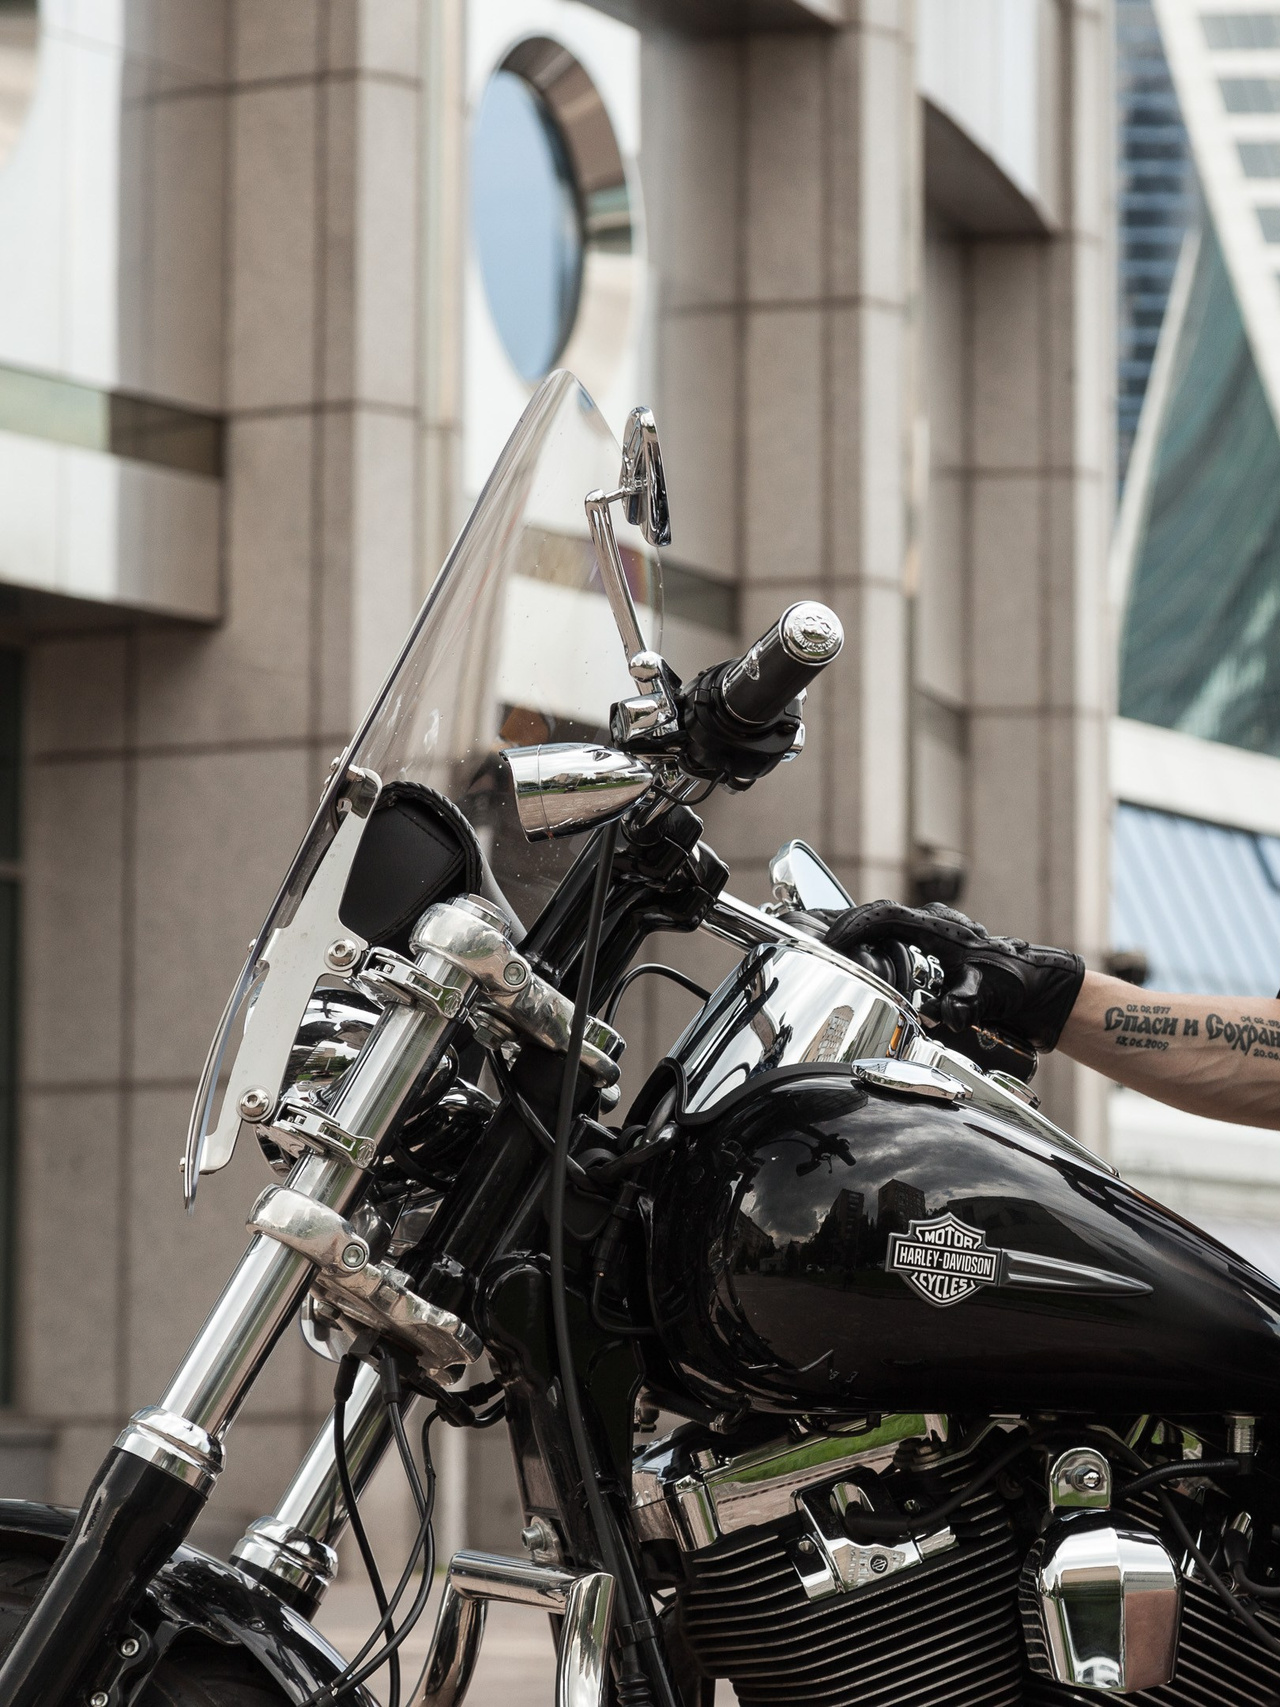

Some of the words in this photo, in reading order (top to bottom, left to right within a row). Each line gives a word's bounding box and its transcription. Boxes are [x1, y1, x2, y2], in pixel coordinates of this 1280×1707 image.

[1104, 1006, 1179, 1036] Спаси
[1183, 1018, 1199, 1036] и
[924, 1226, 974, 1249] MOTOR
[900, 1246, 992, 1275] HARLEY-DAVIDSON
[919, 1273, 968, 1299] CYCLES
